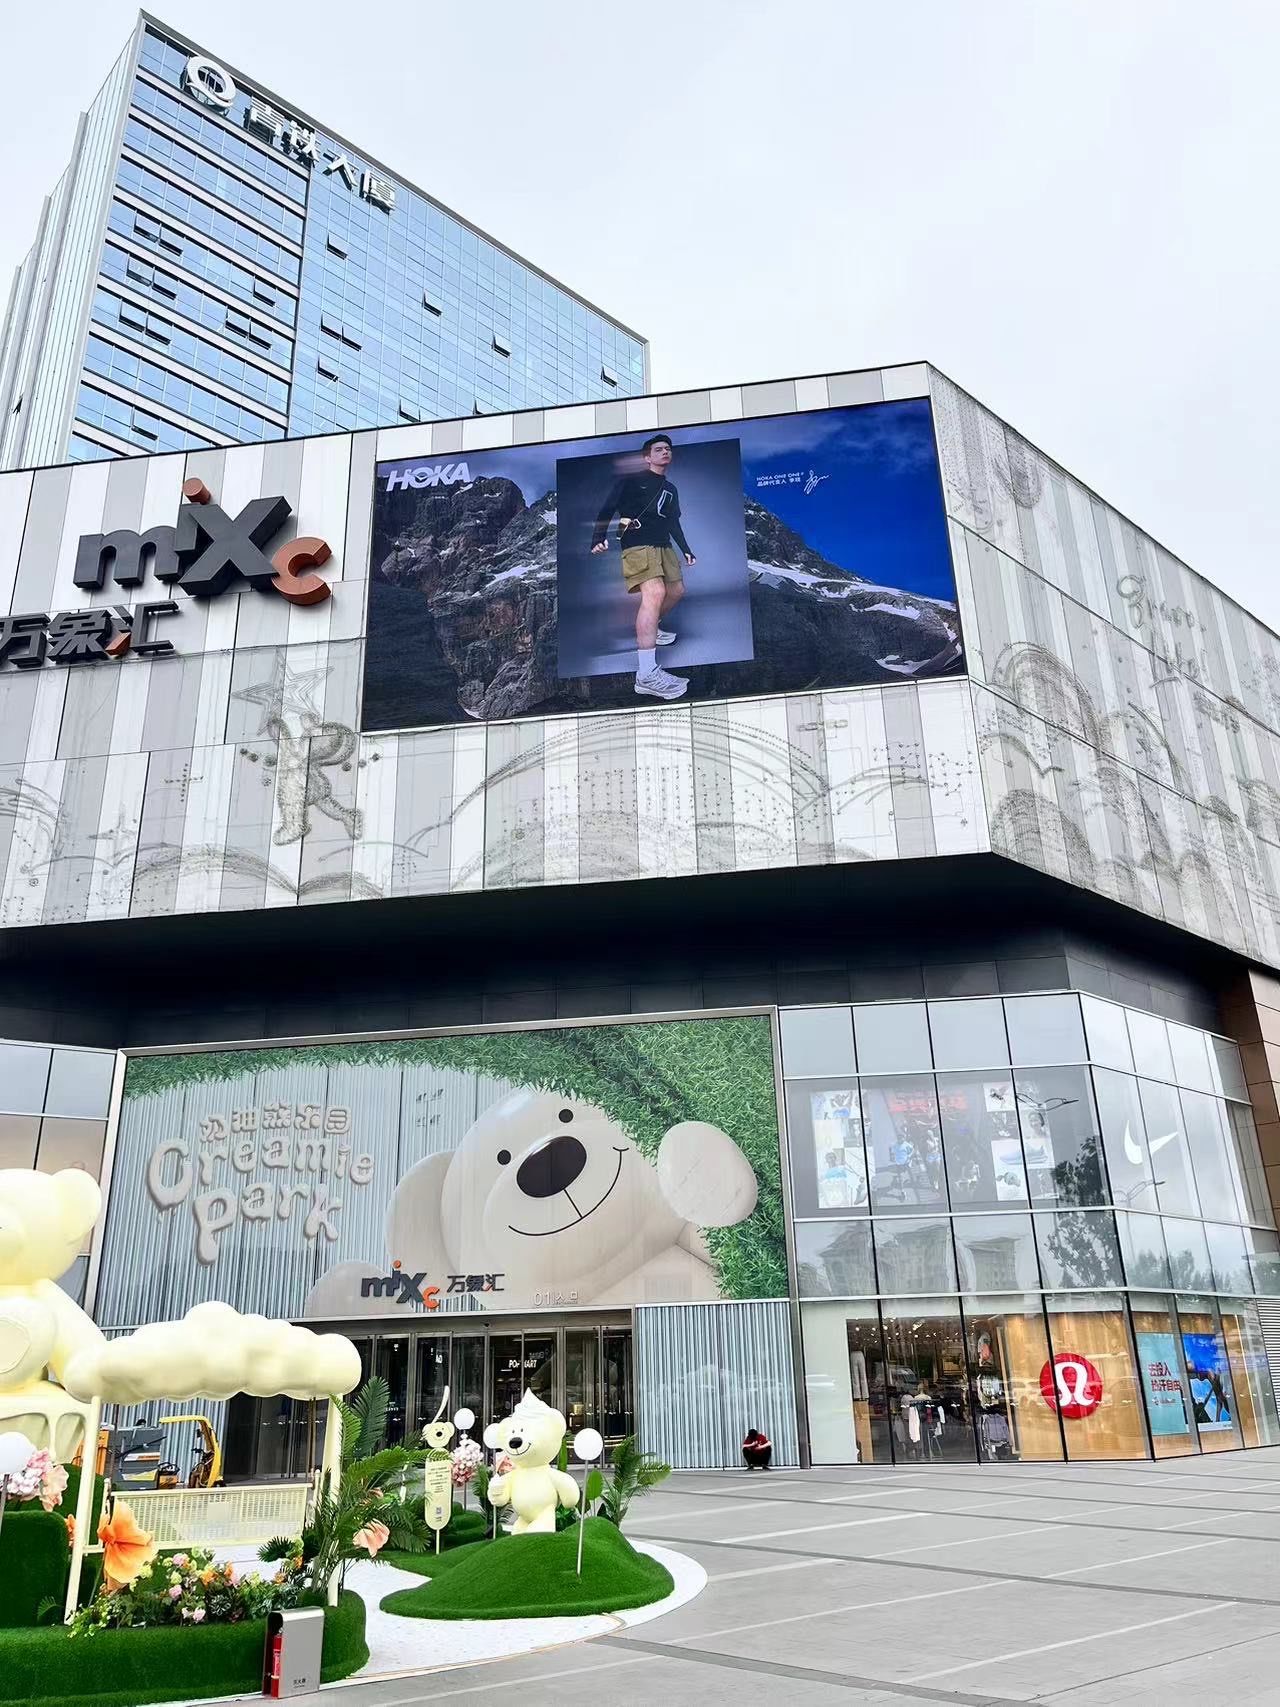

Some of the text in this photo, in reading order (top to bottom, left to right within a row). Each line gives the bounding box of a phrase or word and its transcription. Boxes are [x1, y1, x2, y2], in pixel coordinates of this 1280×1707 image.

[250, 96, 397, 211] 青铁大厦
[386, 462, 472, 491] HOKA
[0, 600, 180, 668] 万象汇
[200, 1098, 350, 1142] 奶油熊乐园
[147, 1136, 374, 1210] Creamie
[447, 1273, 505, 1293] 万象汇
